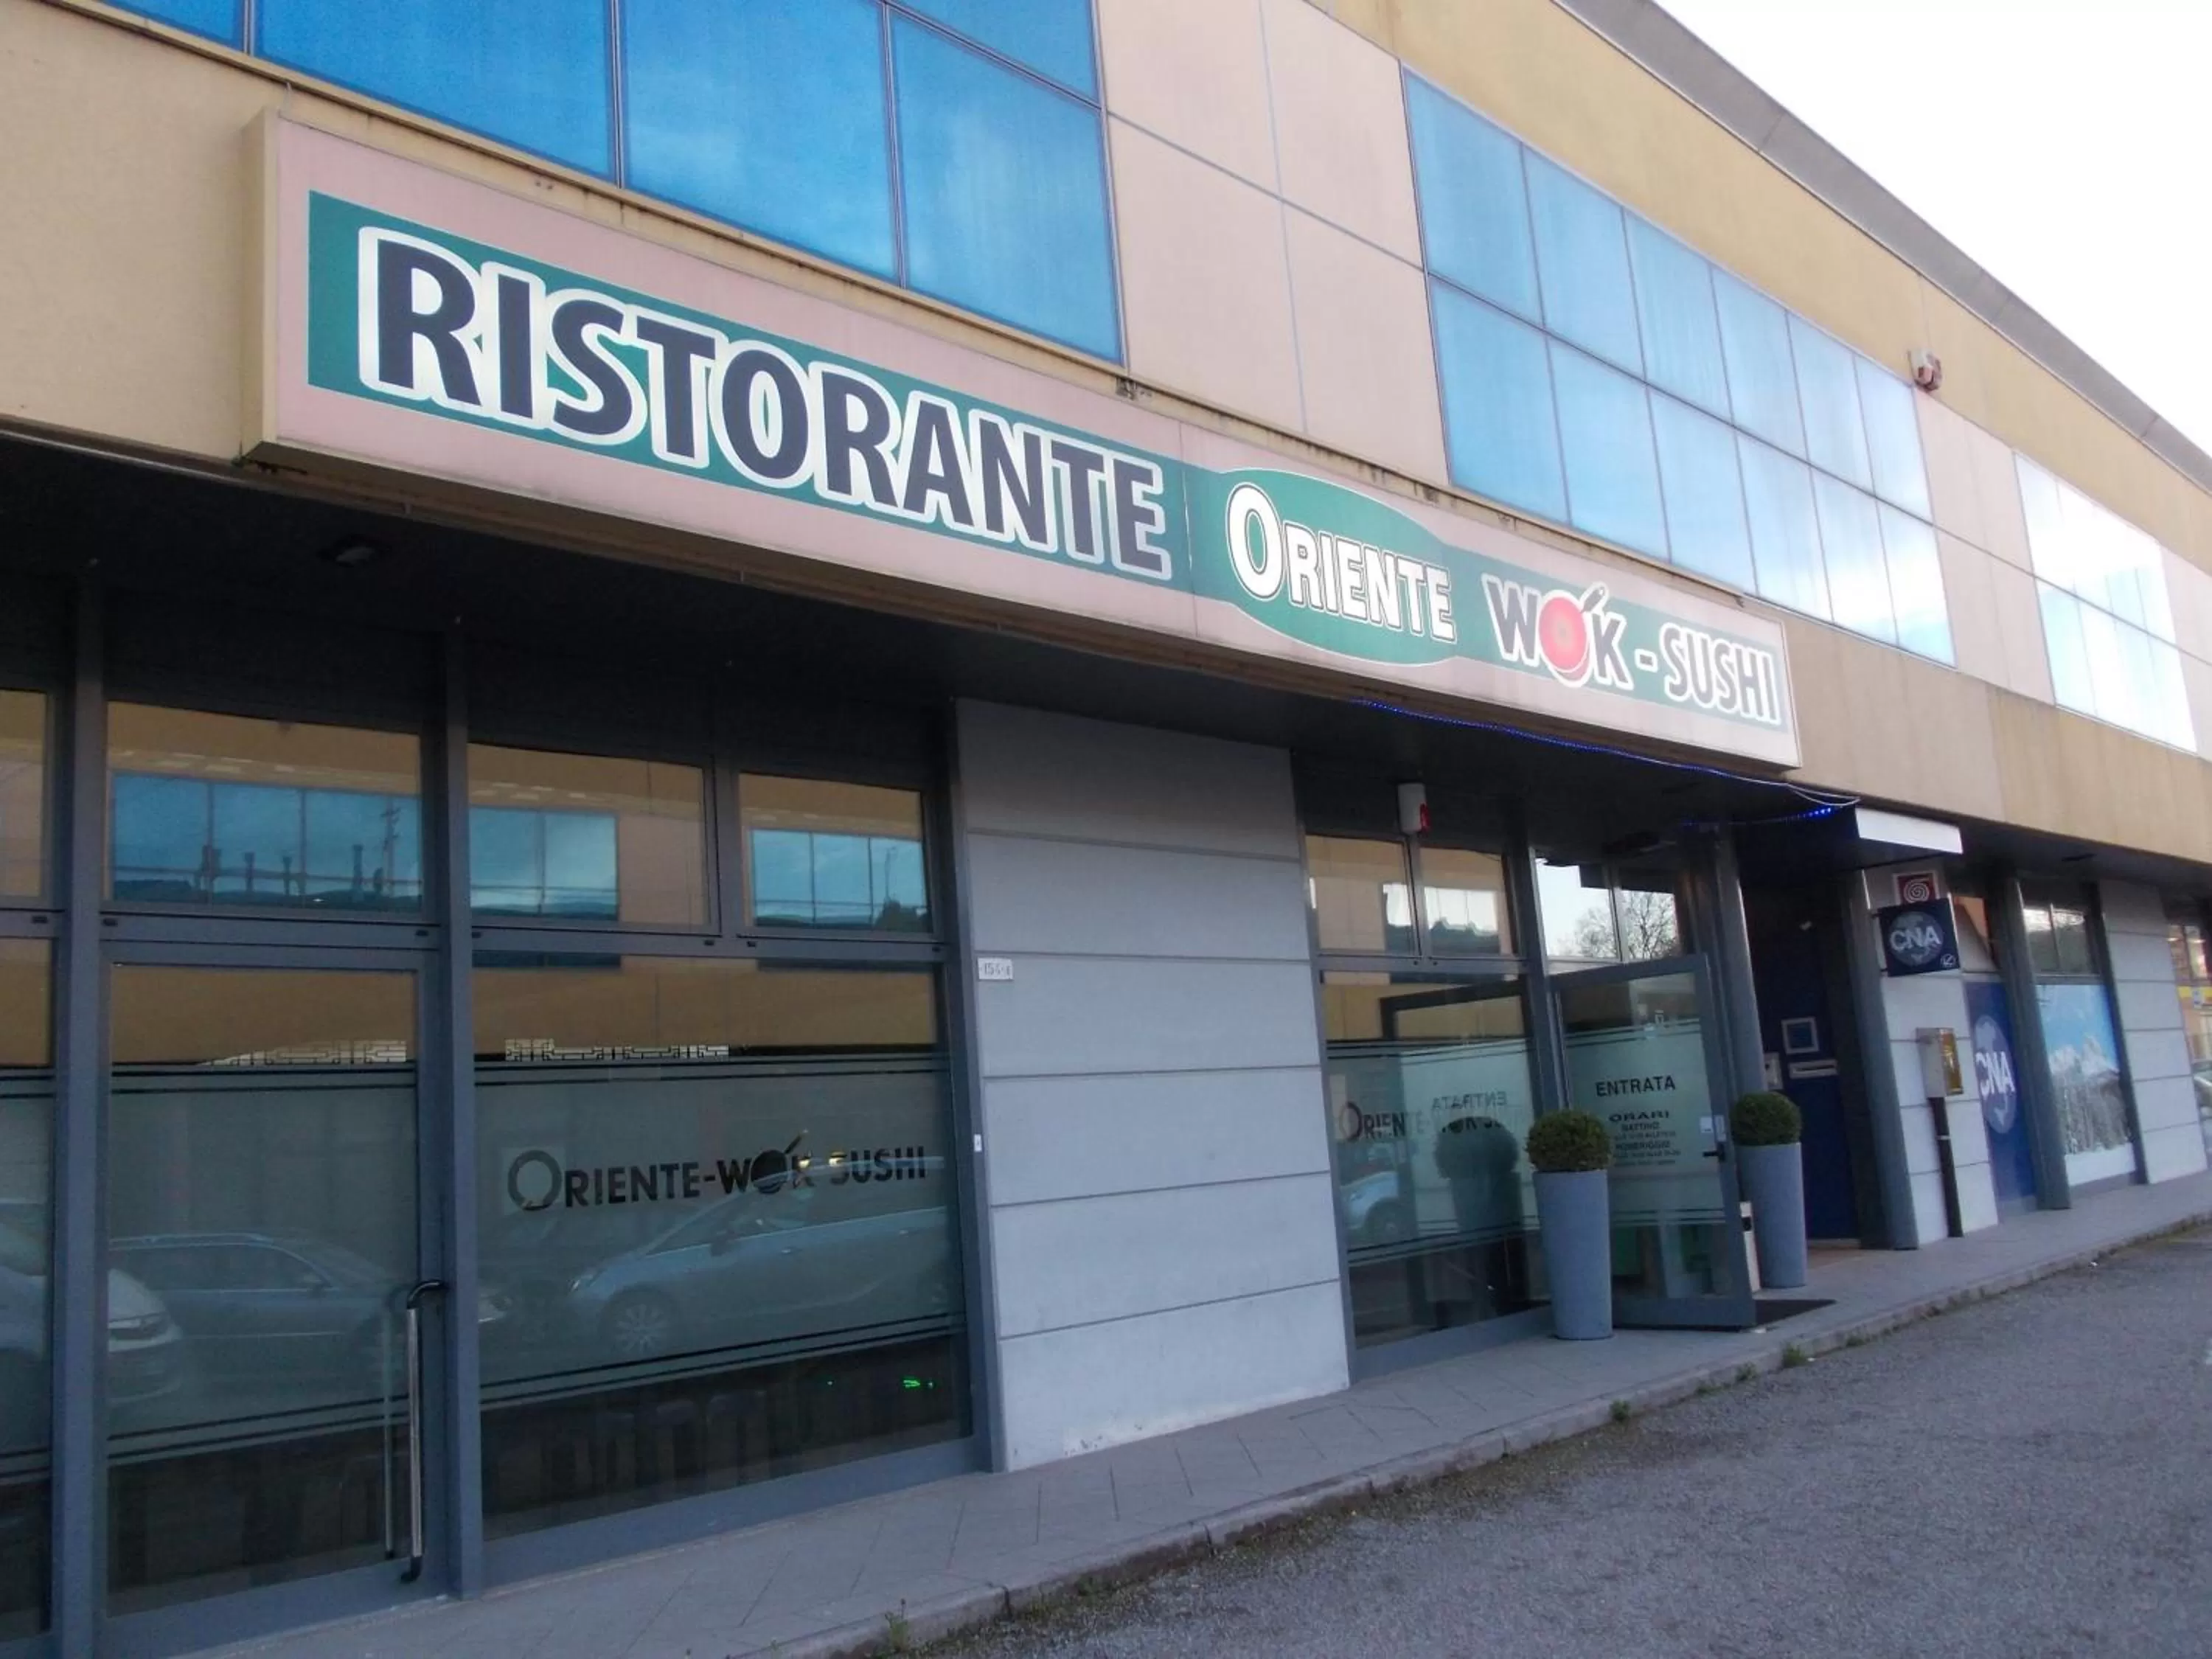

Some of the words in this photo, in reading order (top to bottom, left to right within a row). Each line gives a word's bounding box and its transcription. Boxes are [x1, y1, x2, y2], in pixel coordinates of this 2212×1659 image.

[358, 227, 1172, 580] RISTORANTE
[1226, 482, 1457, 643] ORIENTE
[1890, 925, 1941, 952] CNA
[1595, 1075, 1676, 1097] ENTRATA
[1975, 1051, 2016, 1099] CNA
